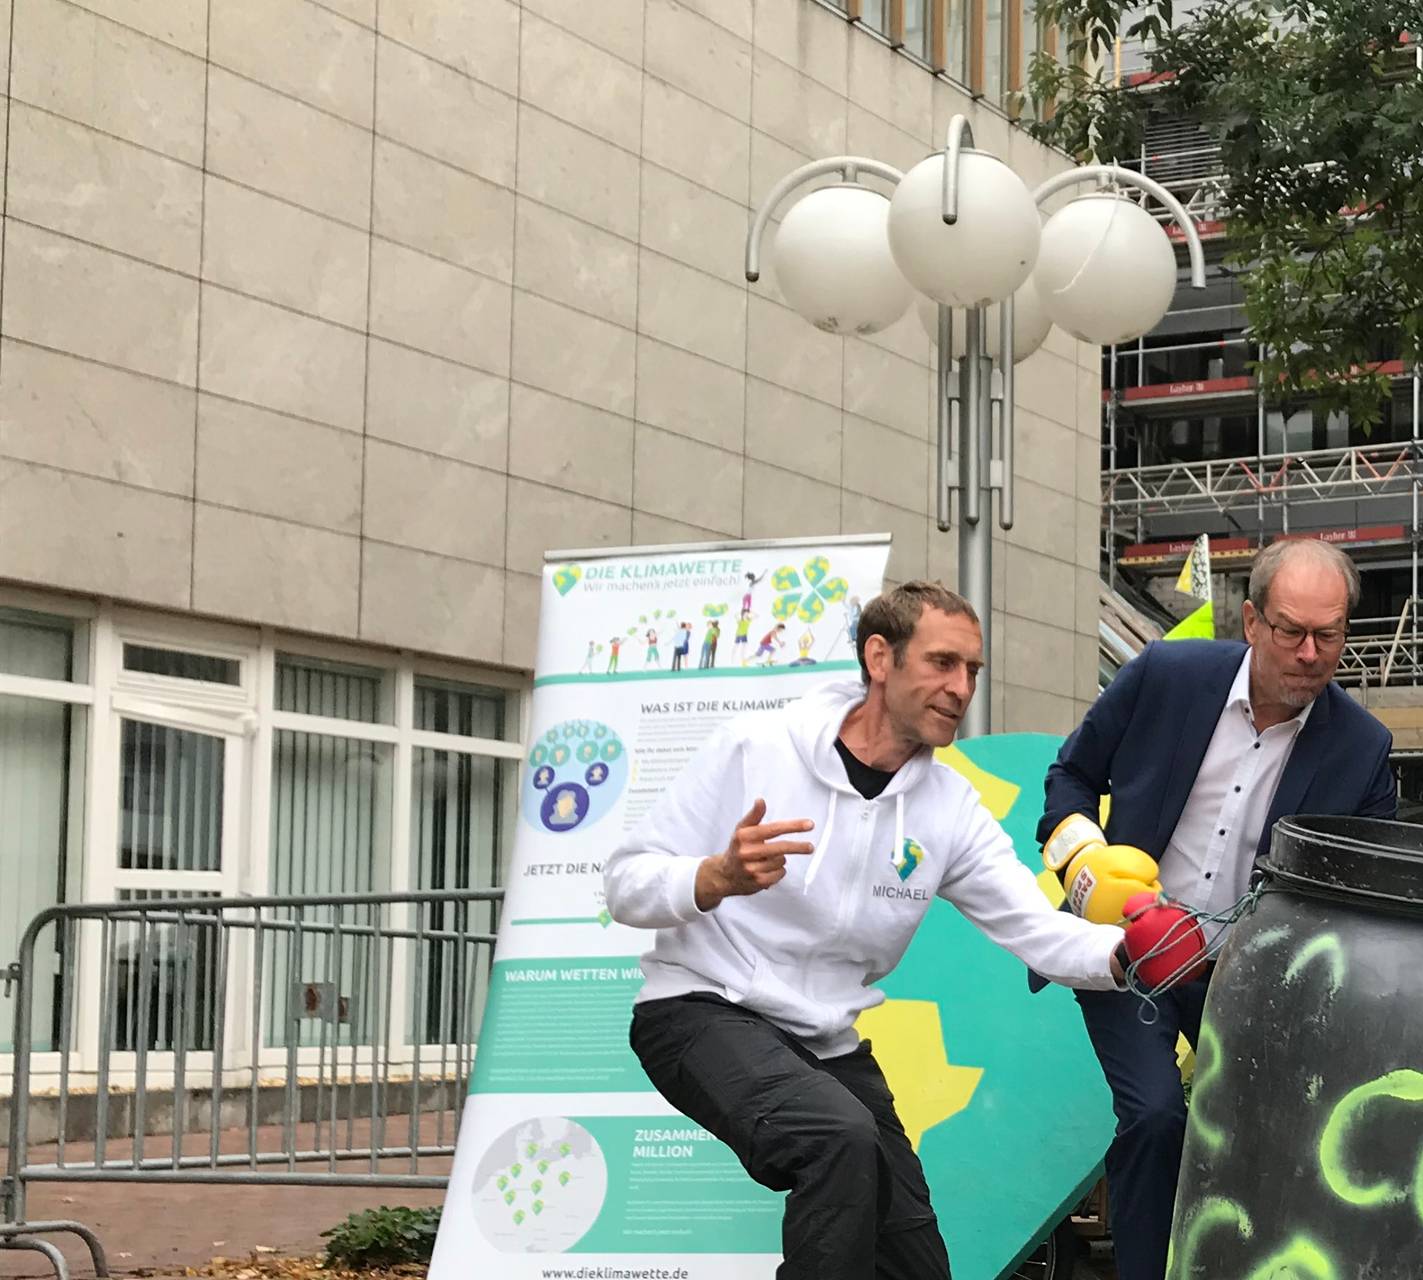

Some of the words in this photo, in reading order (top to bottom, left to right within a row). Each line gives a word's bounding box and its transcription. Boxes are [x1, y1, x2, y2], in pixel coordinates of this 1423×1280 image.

[1320, 531, 1346, 542] Layher
[584, 565, 616, 581] DIE
[620, 559, 743, 579] KLIMAWETTE
[583, 581, 603, 592] Wir
[662, 577, 690, 592] jetzt
[640, 702, 670, 714] WAS
[673, 701, 693, 713] IST
[696, 701, 719, 712] DIE
[523, 863, 563, 876] JETZT
[565, 862, 588, 874] DIE
[872, 885, 929, 900] MICHAEL
[505, 970, 557, 982] WARUM
[560, 968, 618, 981] WETTEN
[632, 1146, 693, 1157] MILLION
[542, 1267, 689, 1279] www.dieklimawette.de
